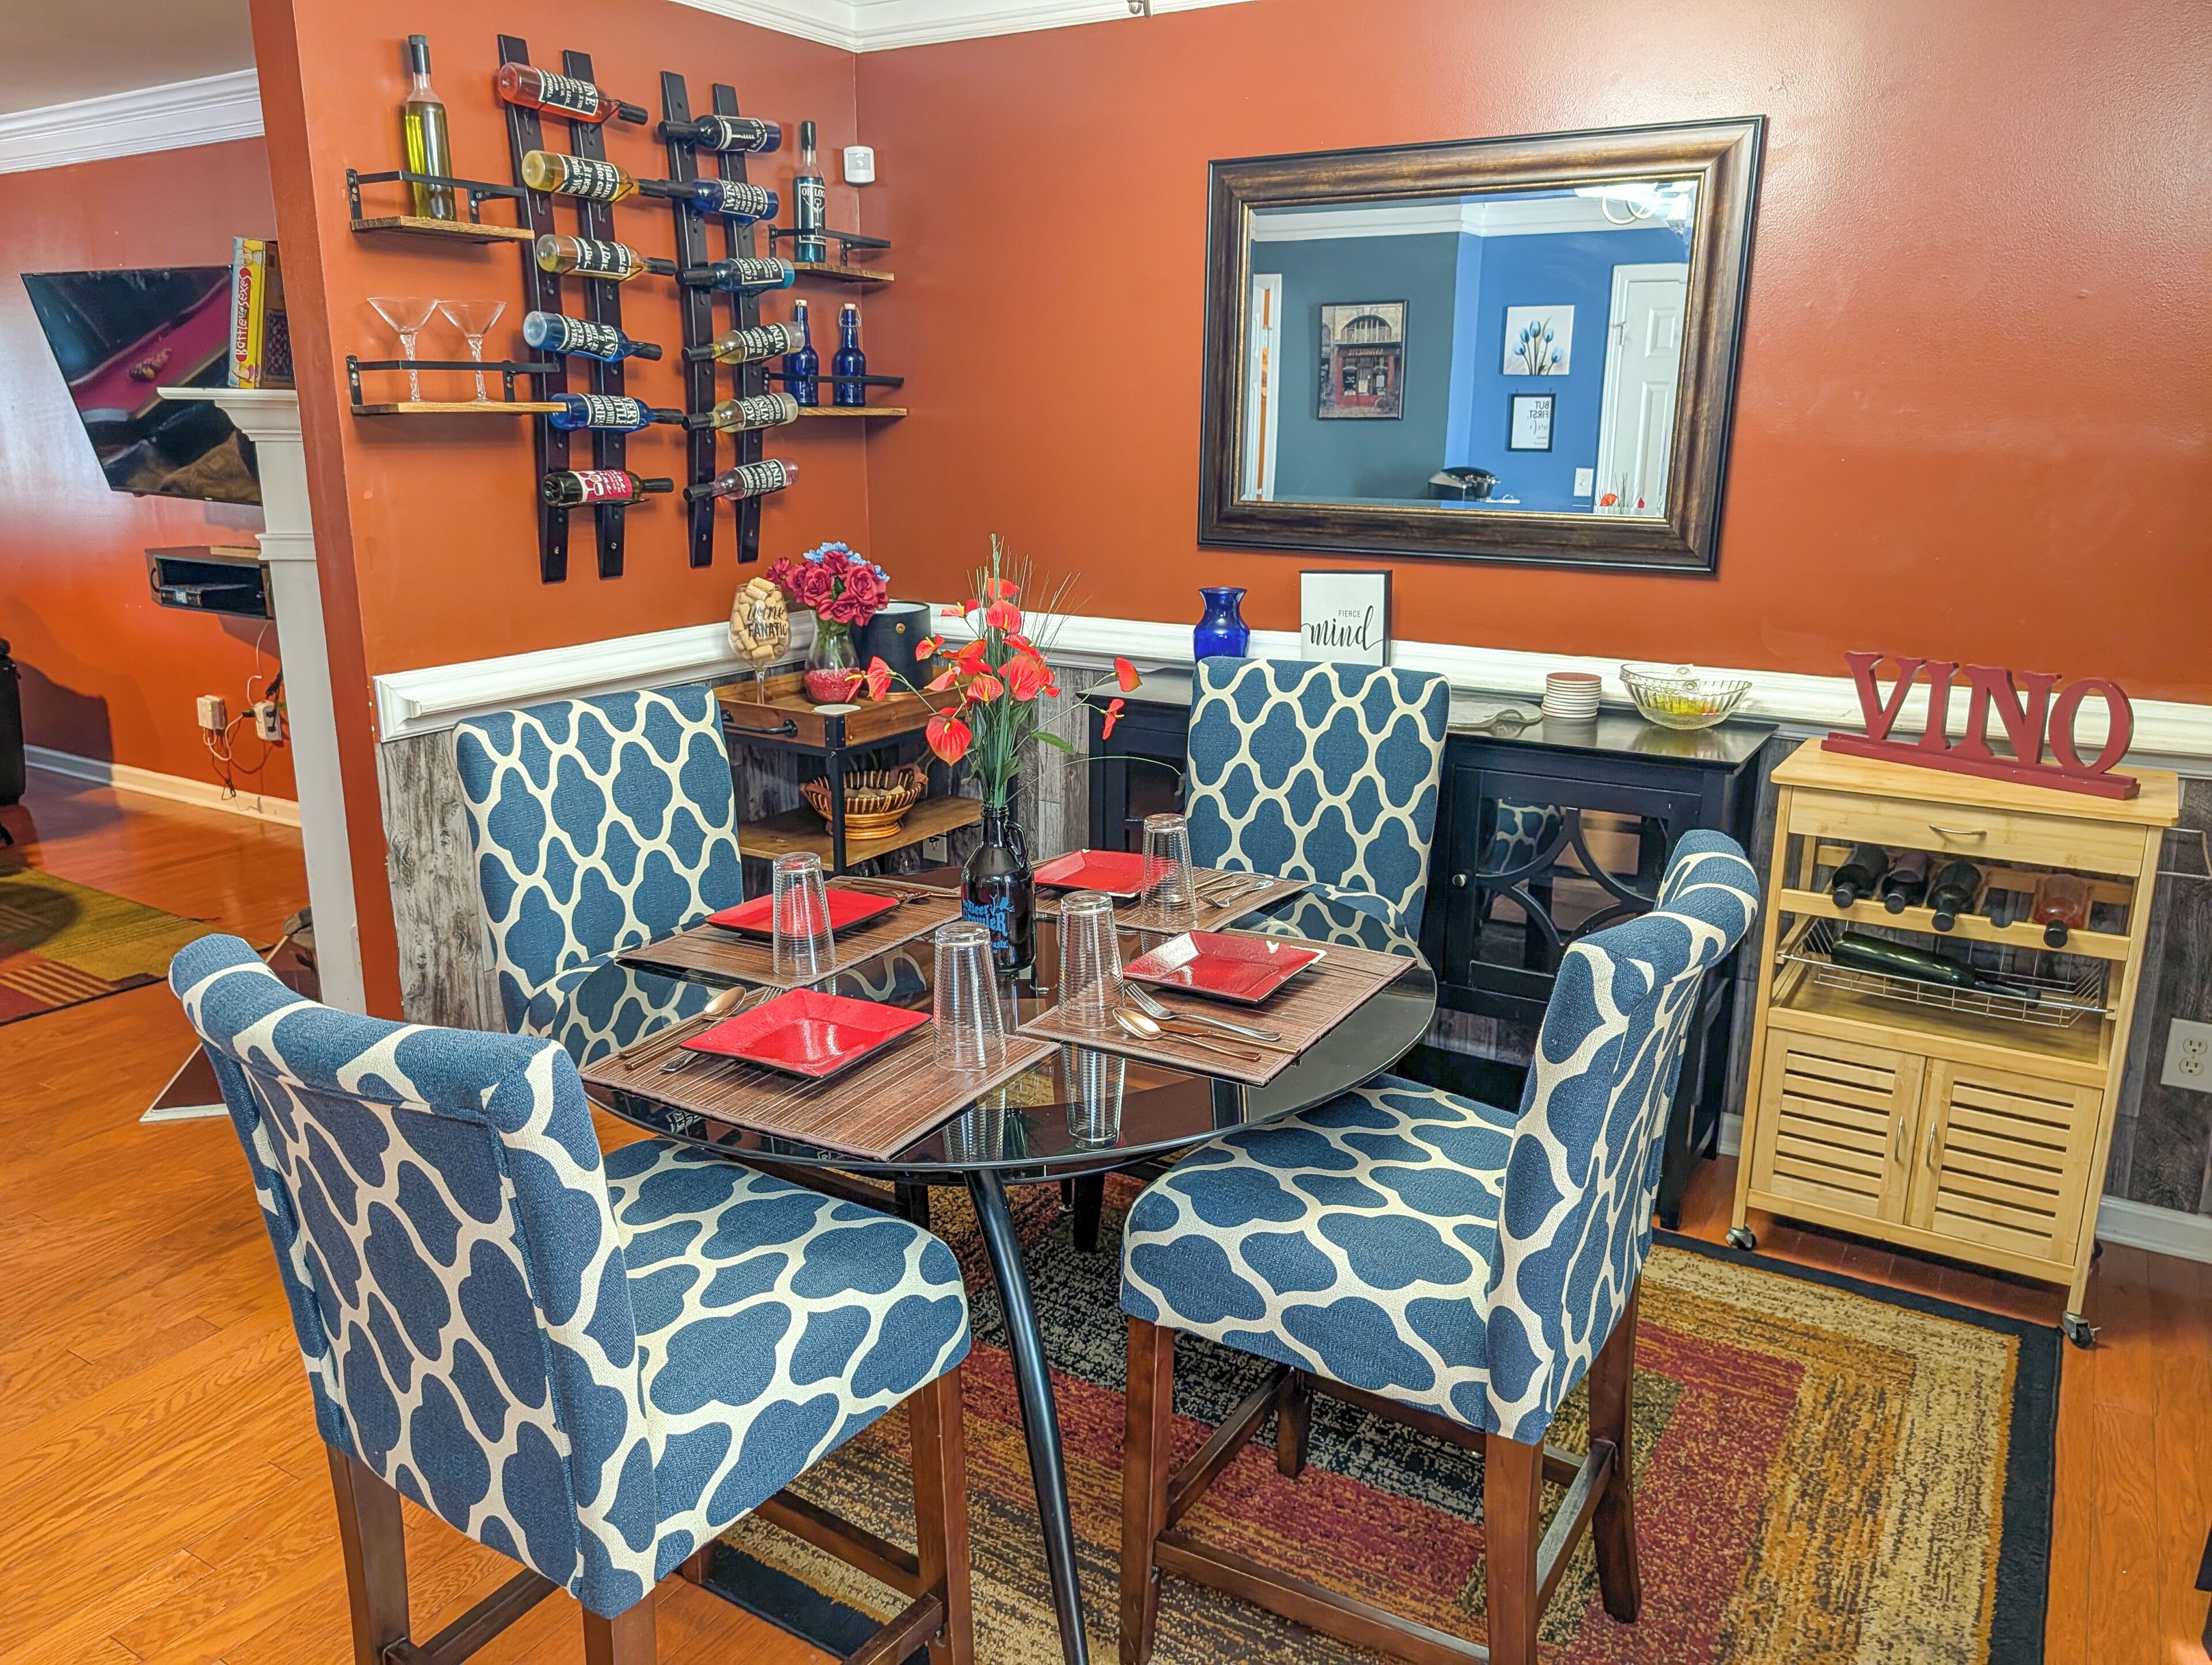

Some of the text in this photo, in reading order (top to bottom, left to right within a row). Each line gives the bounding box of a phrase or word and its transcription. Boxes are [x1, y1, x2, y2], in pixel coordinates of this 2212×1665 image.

[237, 274, 252, 308] Sexes
[235, 319, 248, 355] Battle
[586, 393, 606, 425] TORIES
[621, 397, 637, 424] VERY
[748, 622, 787, 638] FANATIC
[1301, 605, 1384, 651] mind
[1339, 610, 1361, 618] FIERCE
[1844, 650, 2134, 775] VINO
[968, 899, 990, 915] Beer
